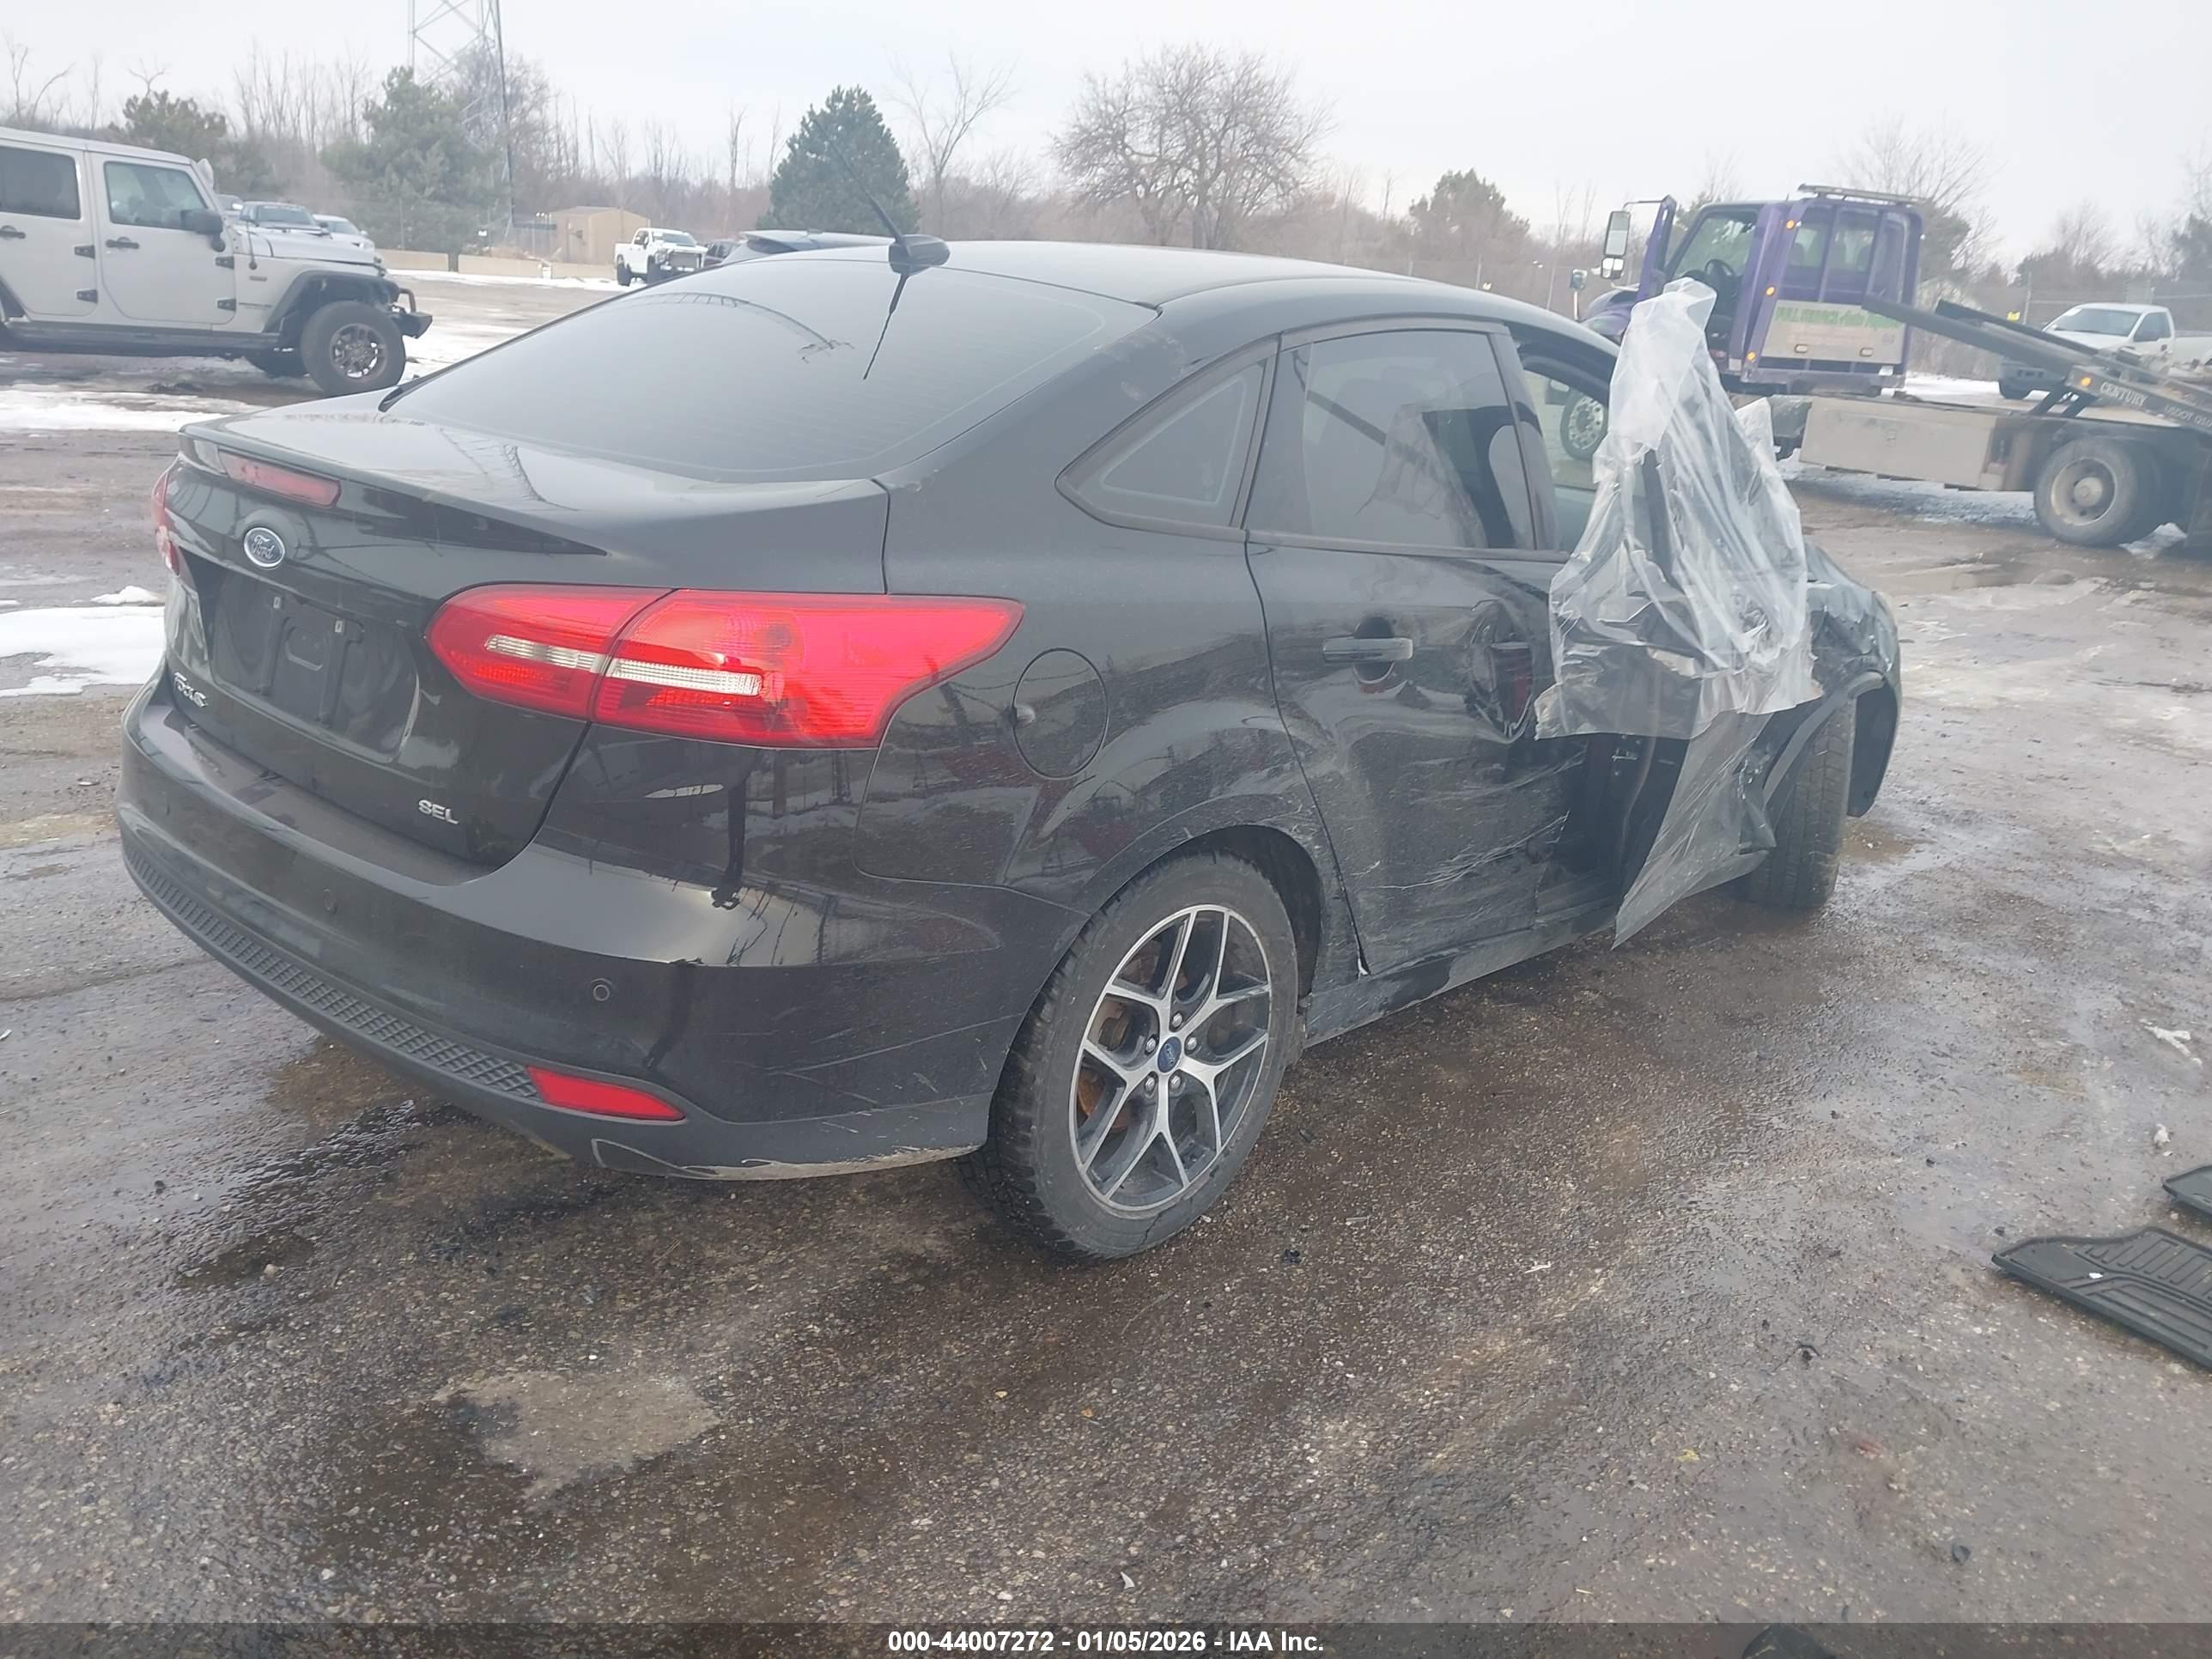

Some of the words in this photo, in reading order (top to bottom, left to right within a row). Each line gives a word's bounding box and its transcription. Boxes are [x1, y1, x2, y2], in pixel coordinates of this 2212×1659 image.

[2100, 381, 2148, 406] CENTURY
[251, 534, 276, 559] Ford
[418, 799, 459, 824] SEL
